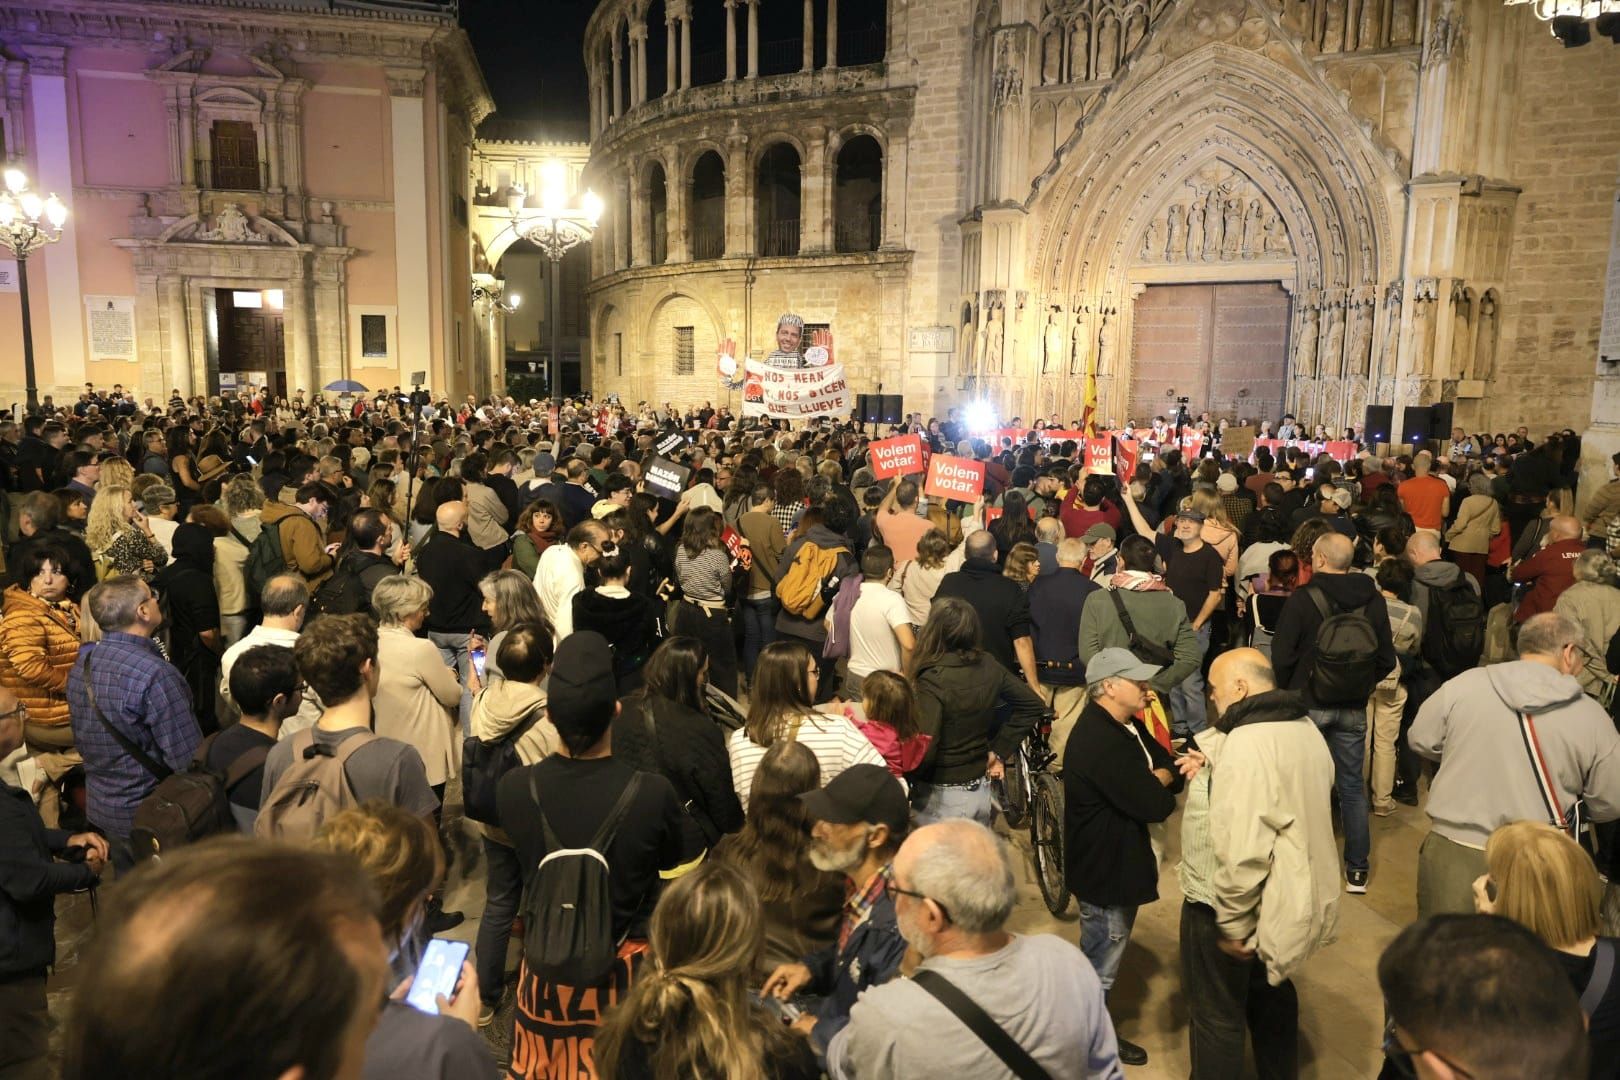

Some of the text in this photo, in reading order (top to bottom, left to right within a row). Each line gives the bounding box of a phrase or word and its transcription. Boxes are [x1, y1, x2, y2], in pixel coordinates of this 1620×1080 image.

[764, 371, 824, 383] NOS MEAN
[778, 390, 799, 400] NOS
[768, 397, 843, 414] QUE LLUEVE
[875, 443, 916, 458] Volem
[1091, 444, 1112, 456] Vol
[880, 456, 916, 470] votar.
[650, 465, 681, 483] MAZÓN
[936, 462, 979, 480] Volem
[935, 477, 974, 493] votar.
